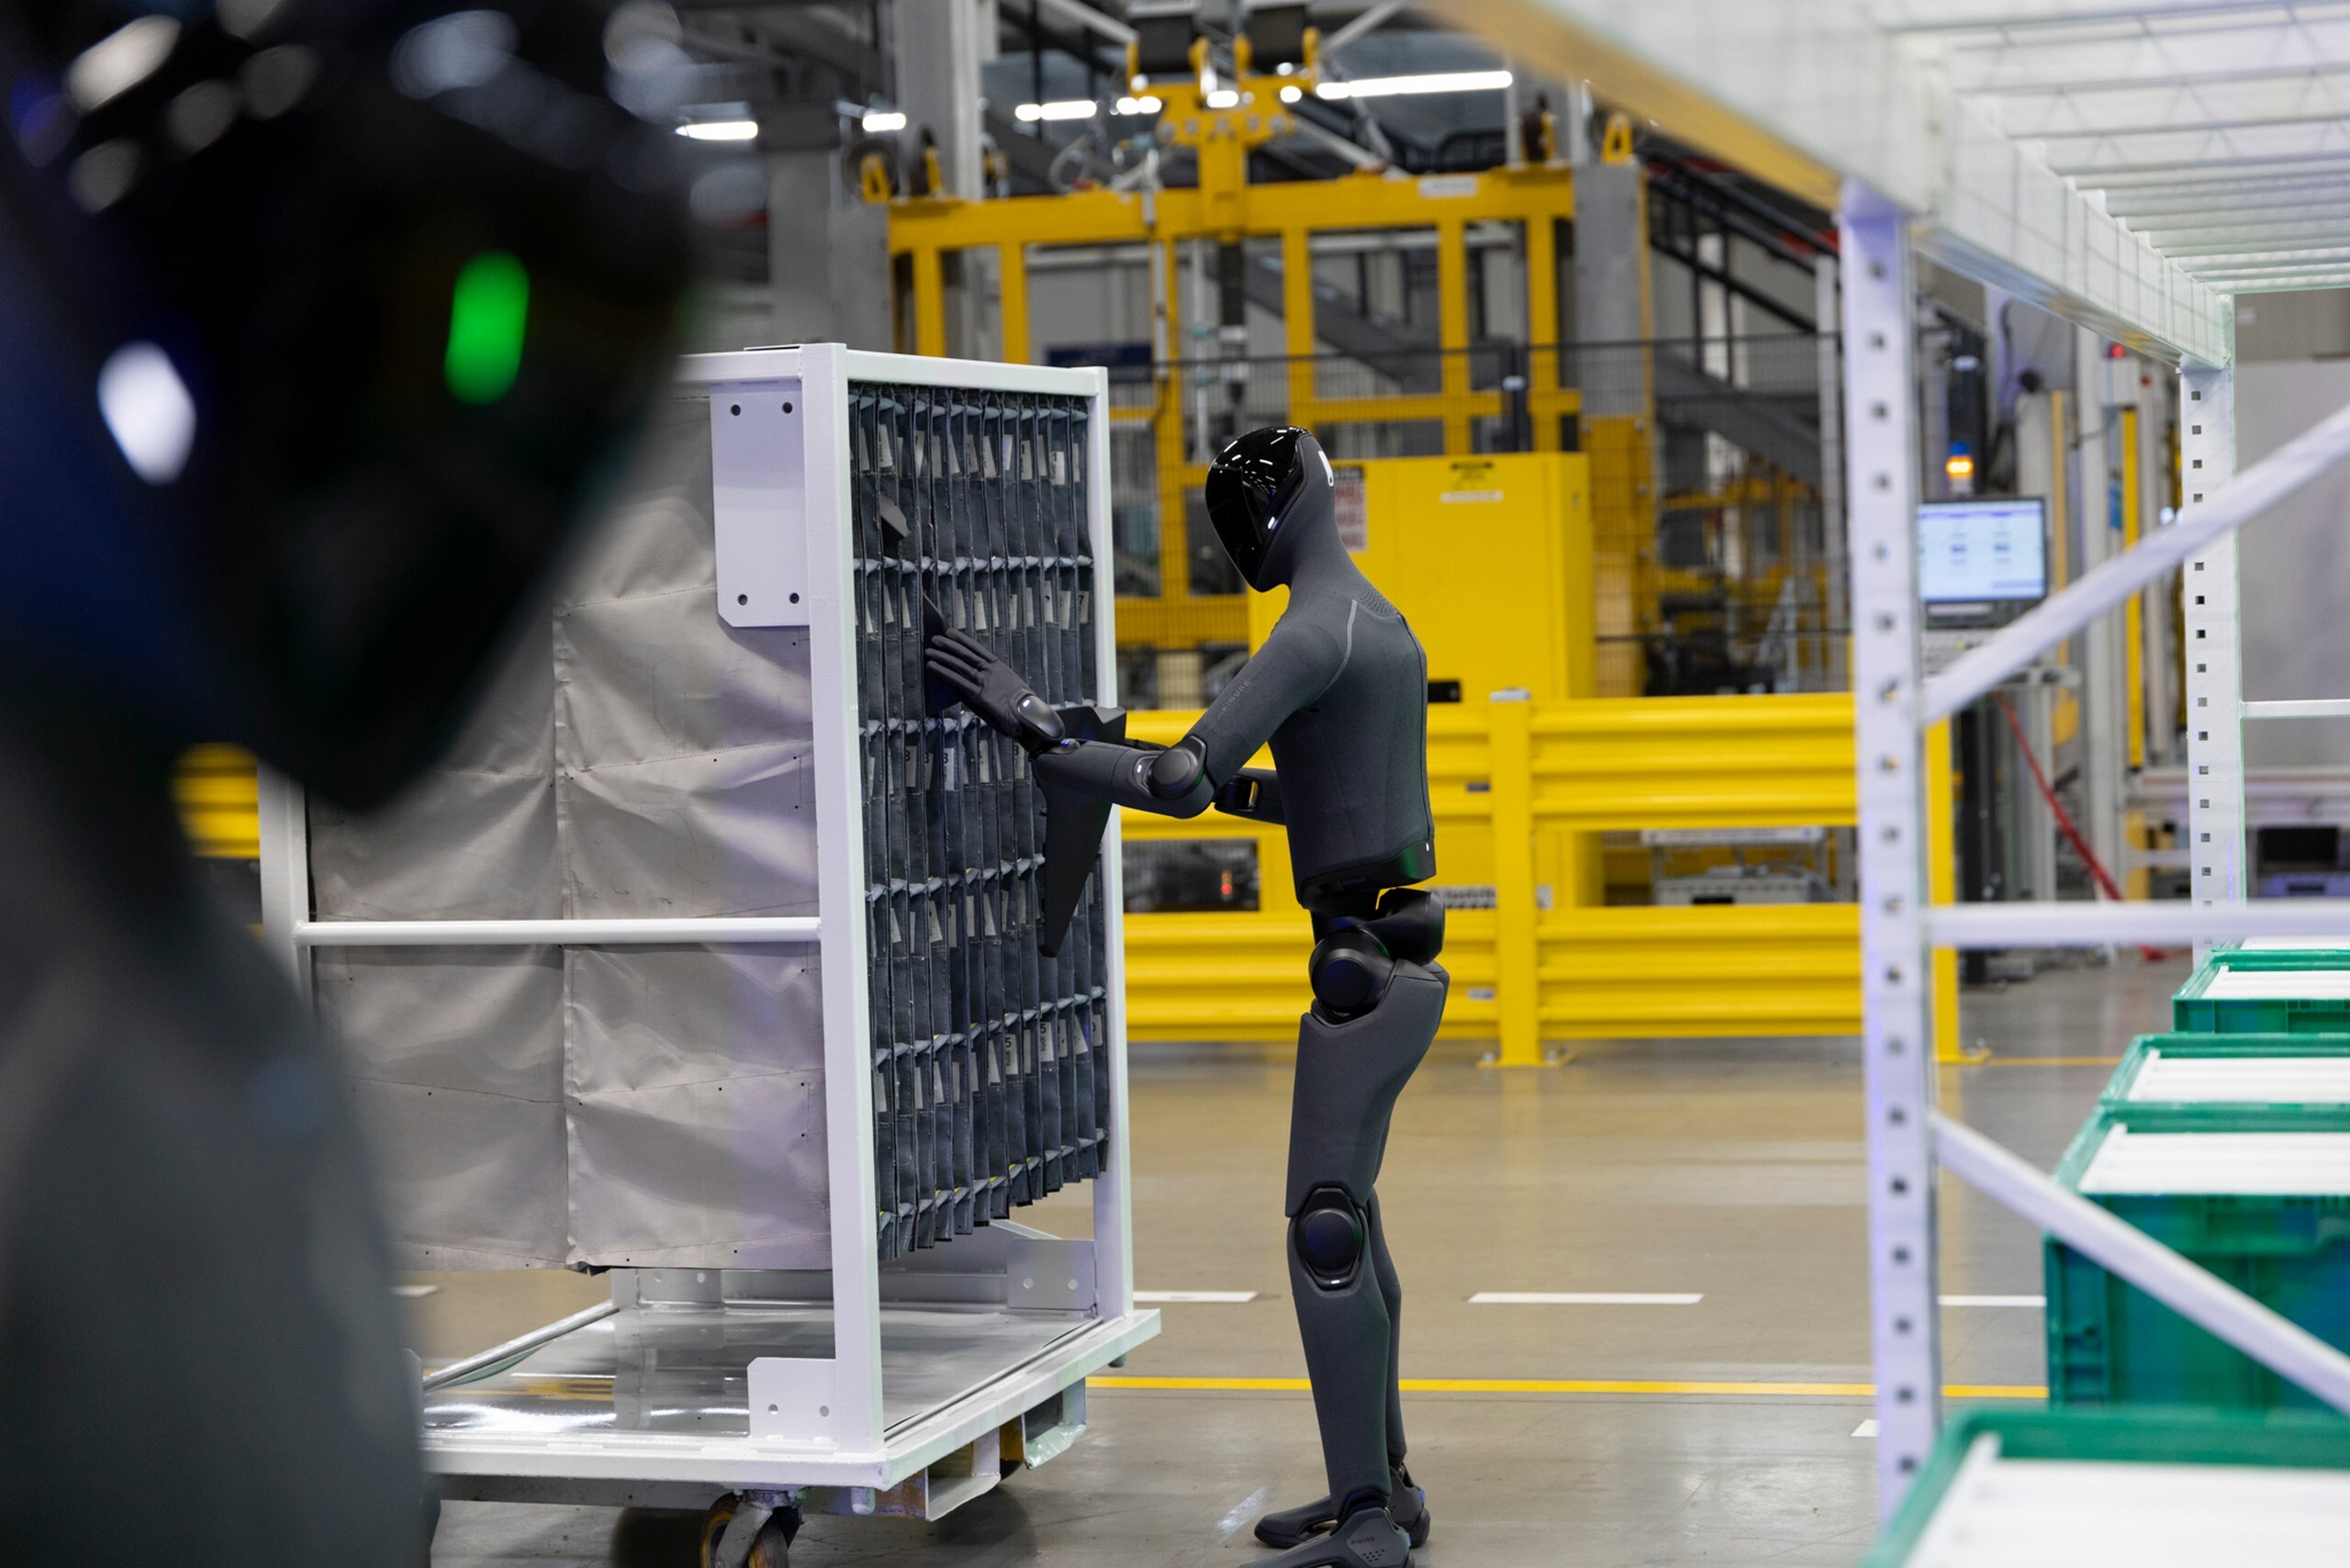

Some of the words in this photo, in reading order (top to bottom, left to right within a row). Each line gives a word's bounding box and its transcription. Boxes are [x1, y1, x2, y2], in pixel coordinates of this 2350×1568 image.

[1079, 595, 1085, 606] 7
[1040, 1024, 1046, 1034] 5
[1005, 1037, 1012, 1047] 5
